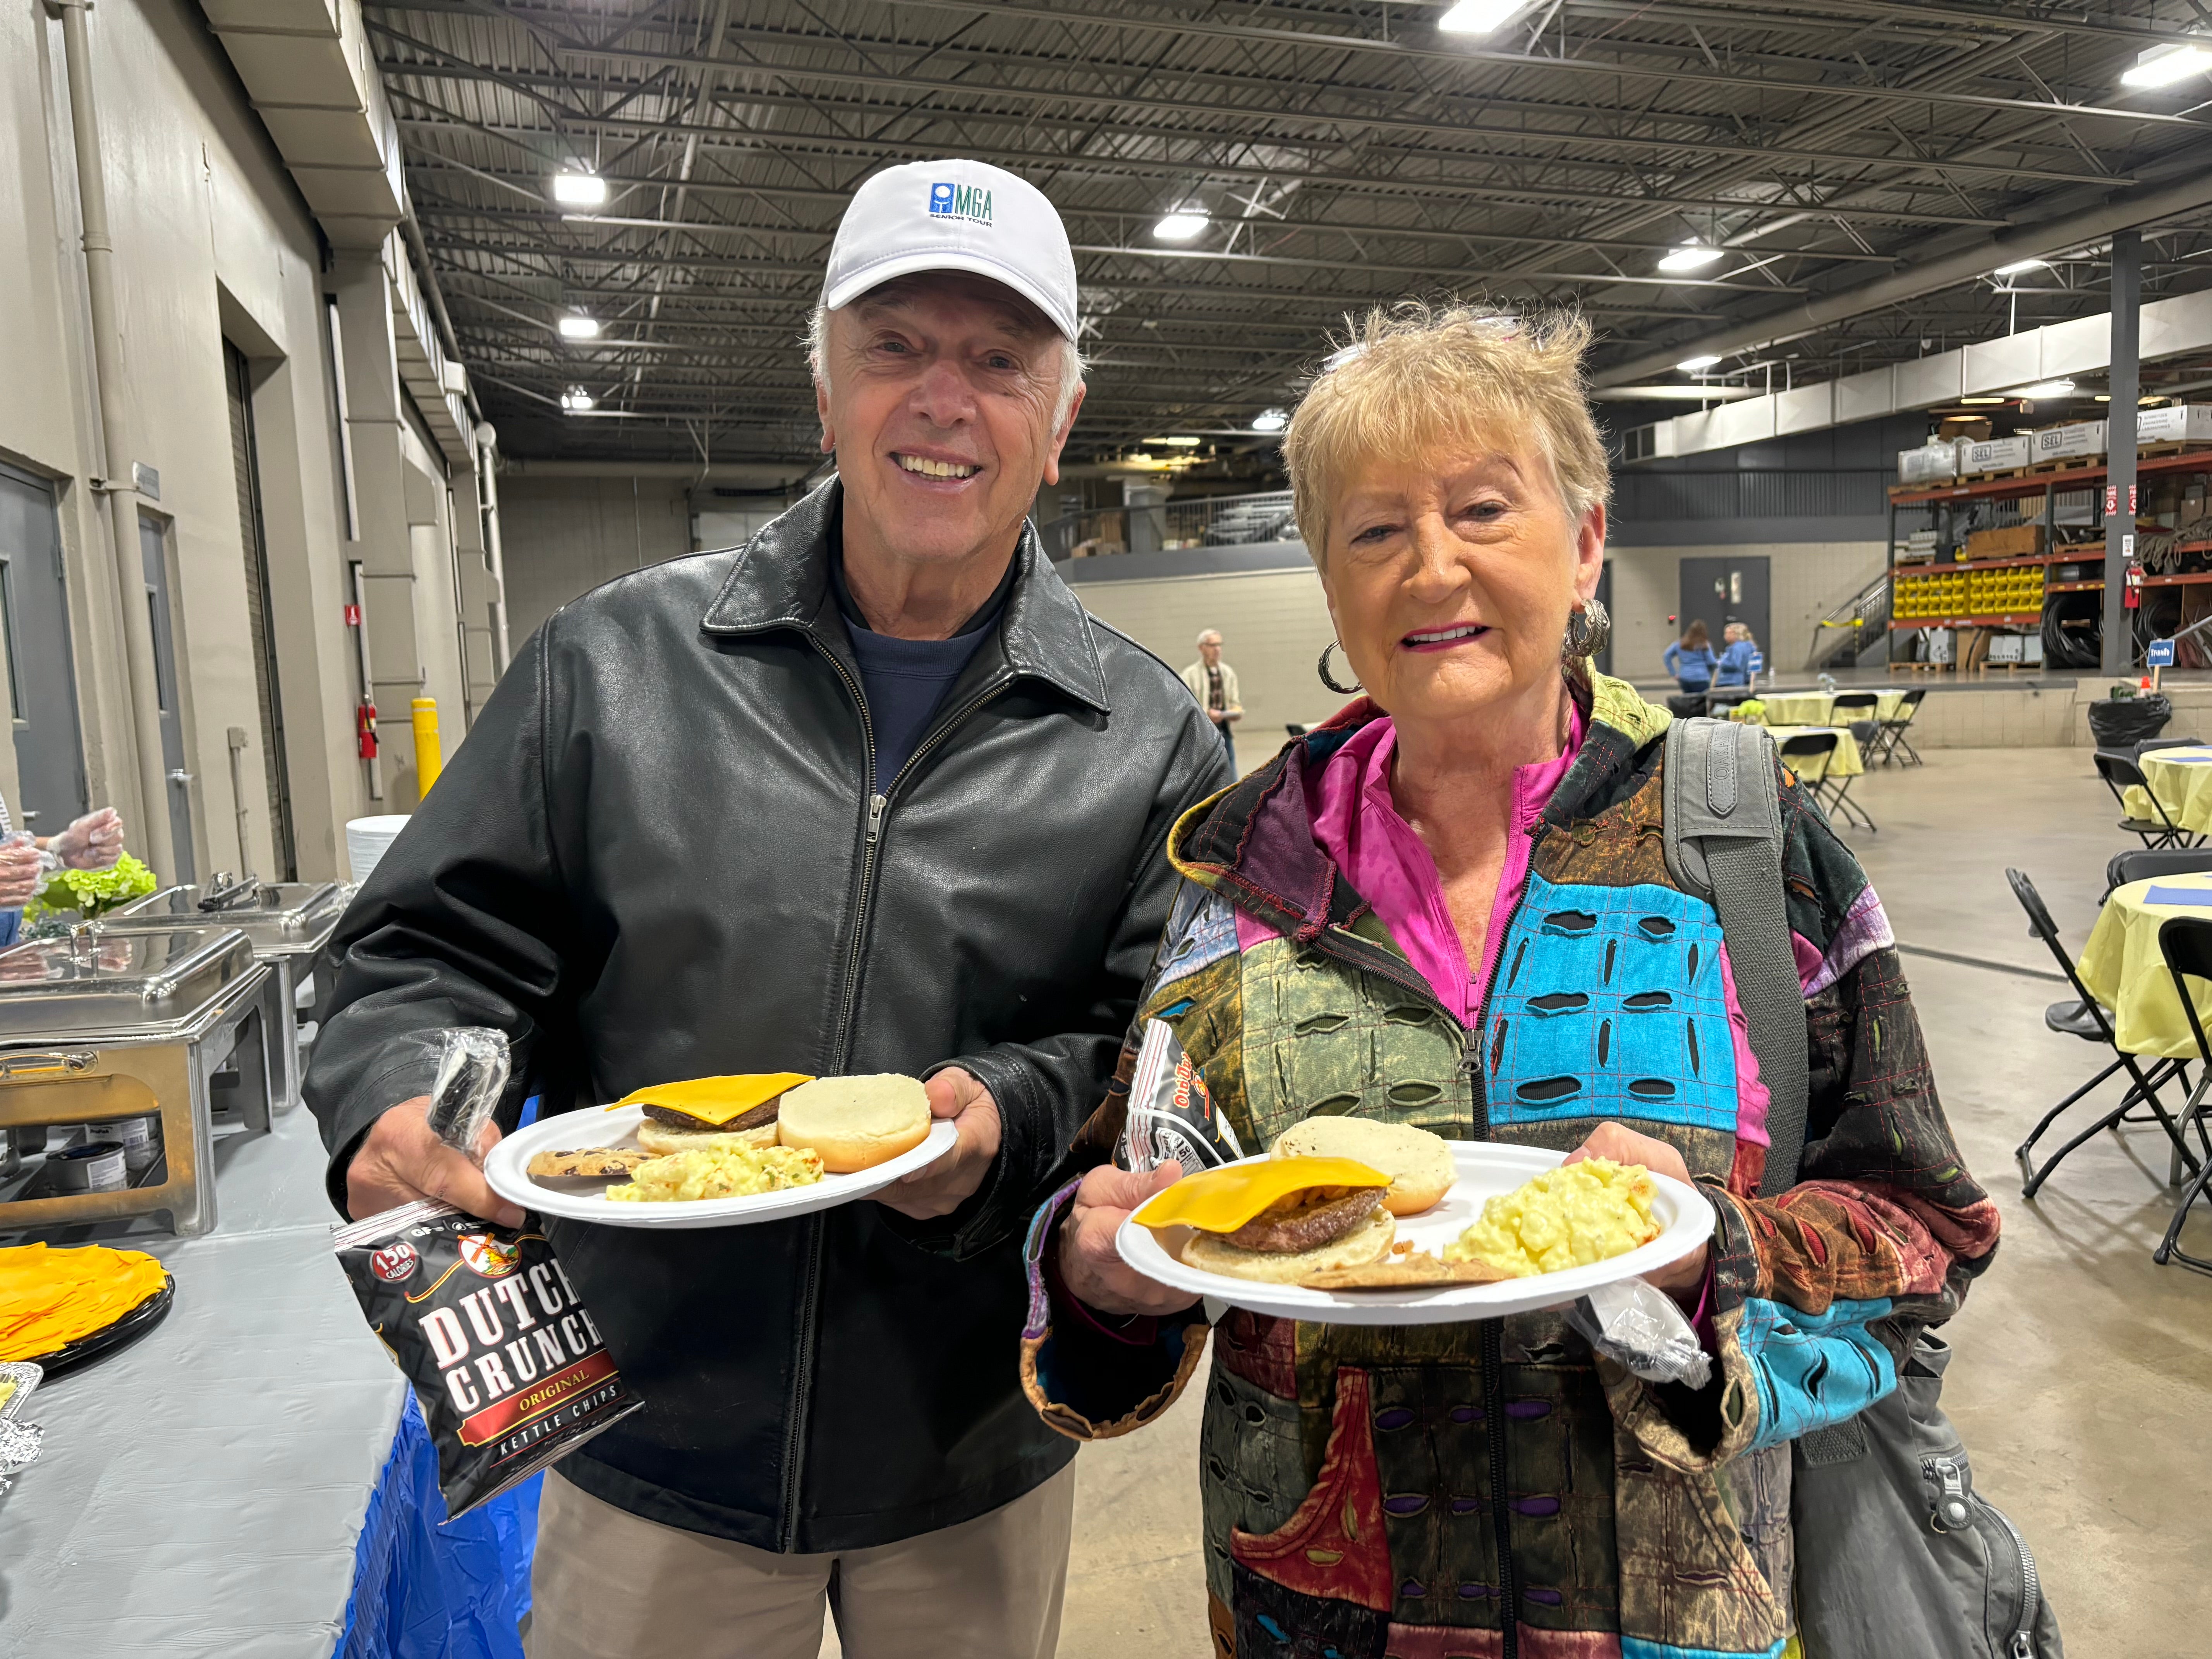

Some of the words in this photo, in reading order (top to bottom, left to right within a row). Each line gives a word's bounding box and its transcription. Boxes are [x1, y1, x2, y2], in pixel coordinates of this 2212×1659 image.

[955, 184, 992, 220] MGA
[967, 217, 992, 227] TOUR
[1974, 447, 1989, 459] SEL
[2044, 434, 2059, 447] SEL
[1173, 1078, 1190, 1108] Old
[411, 1226, 433, 1237] GF
[376, 1245, 410, 1271] 150
[386, 1258, 414, 1279] CALORIES
[446, 1309, 603, 1413] CRUNCH
[519, 1369, 589, 1411] ORIGINAL
[500, 1415, 561, 1455] KETTLE
[572, 1385, 616, 1417] CHIPS
